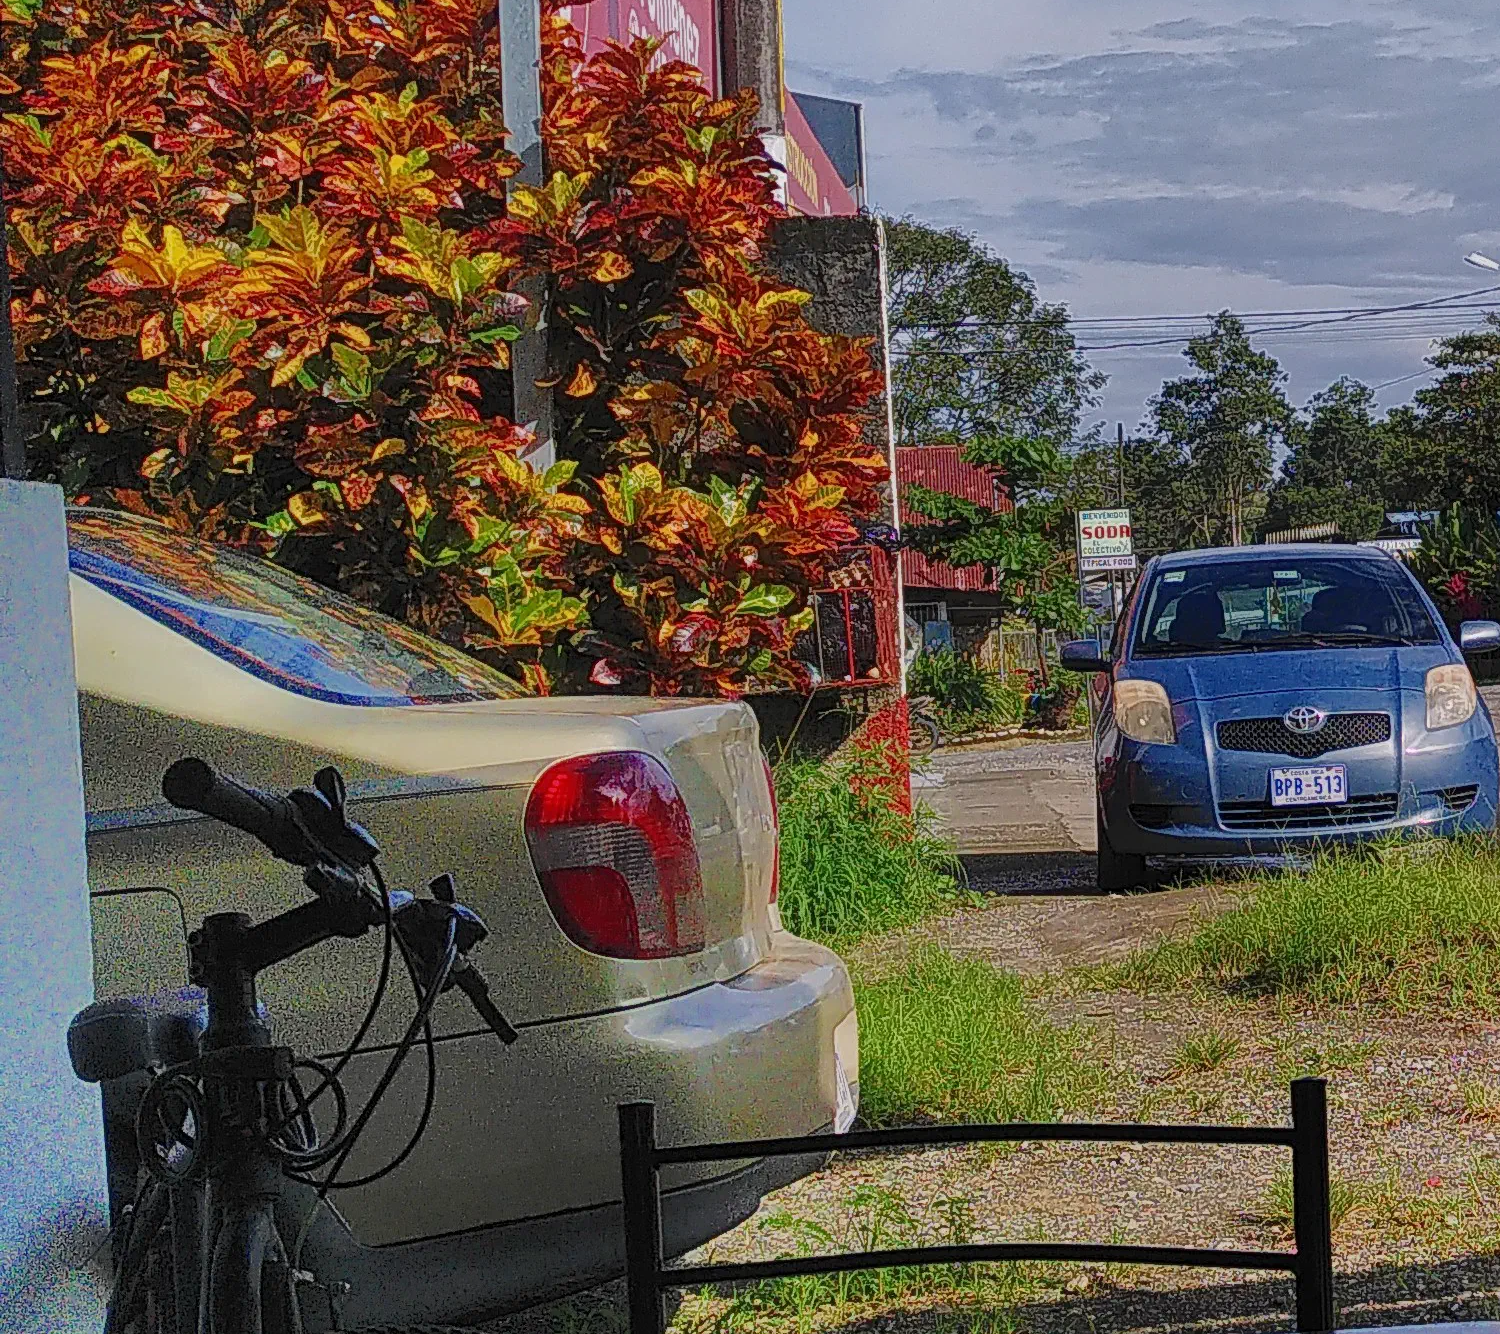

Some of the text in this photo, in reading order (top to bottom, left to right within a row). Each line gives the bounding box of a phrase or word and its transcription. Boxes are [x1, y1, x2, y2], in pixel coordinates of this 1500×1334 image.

[1081, 524, 1131, 540] SODA
[1082, 546, 1121, 555] COLECTIVO
[1113, 558, 1133, 566] FOOD
[1274, 774, 1342, 797] BPB-513
